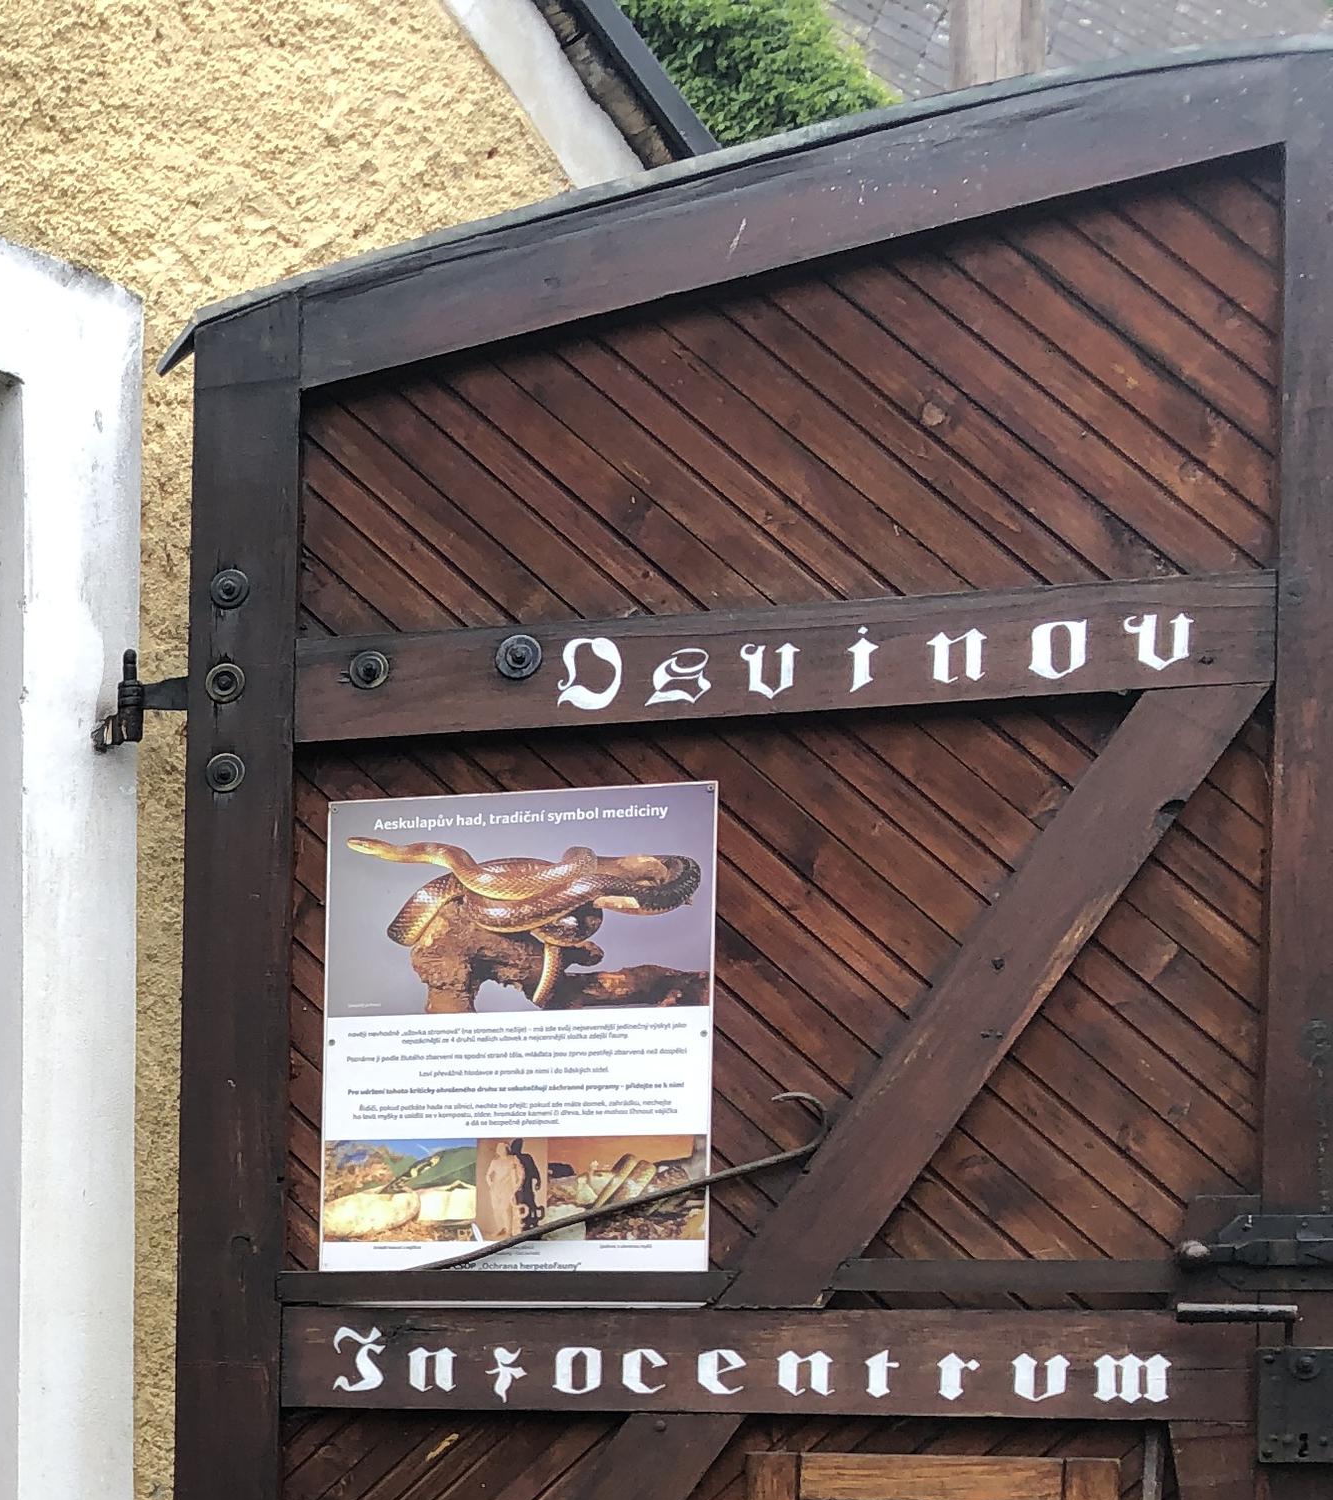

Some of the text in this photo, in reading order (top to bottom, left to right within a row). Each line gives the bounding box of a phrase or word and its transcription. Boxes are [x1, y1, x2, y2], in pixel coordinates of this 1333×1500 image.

[373, 814, 453, 831] Aeskulapův
[456, 812, 487, 828] had,
[489, 809, 545, 825] tradiční
[547, 806, 599, 824] symbol
[333, 1325, 1173, 1404] Infocentrum
